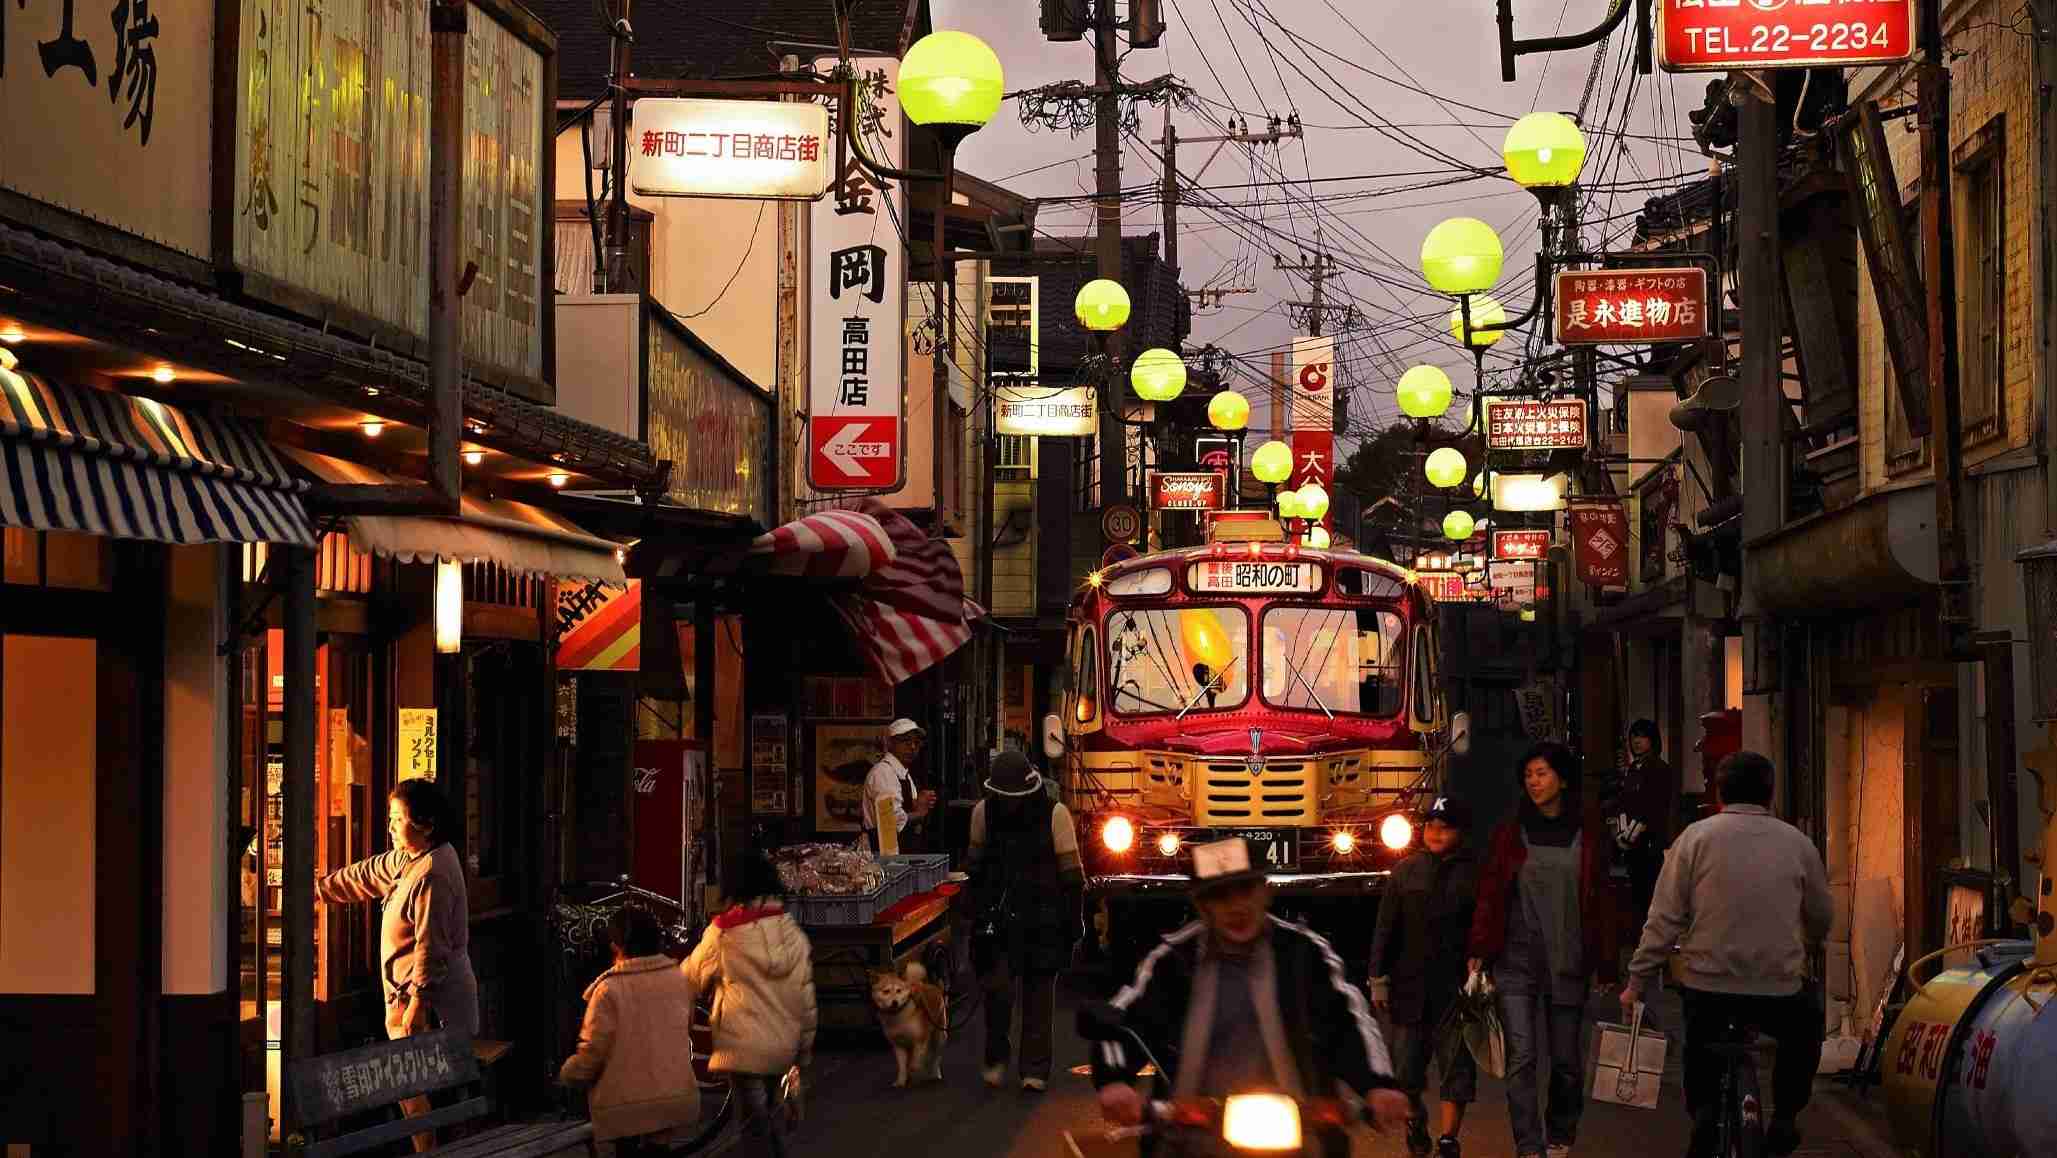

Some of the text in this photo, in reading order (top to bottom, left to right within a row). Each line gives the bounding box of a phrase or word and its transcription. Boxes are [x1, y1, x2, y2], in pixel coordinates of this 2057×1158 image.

[1684, 22, 1889, 54] TEL.22-2234
[641, 119, 820, 162] 新町二丁目商店街
[1565, 295, 1698, 331] 是永進物店
[840, 315, 870, 408] 高田店
[1000, 403, 1093, 419] 新町二丁目商店街
[834, 443, 883, 457] ここです
[1235, 563, 1300, 588] 昭和の町
[411, 738, 422, 770] ソフト
[1432, 797, 1449, 811] K
